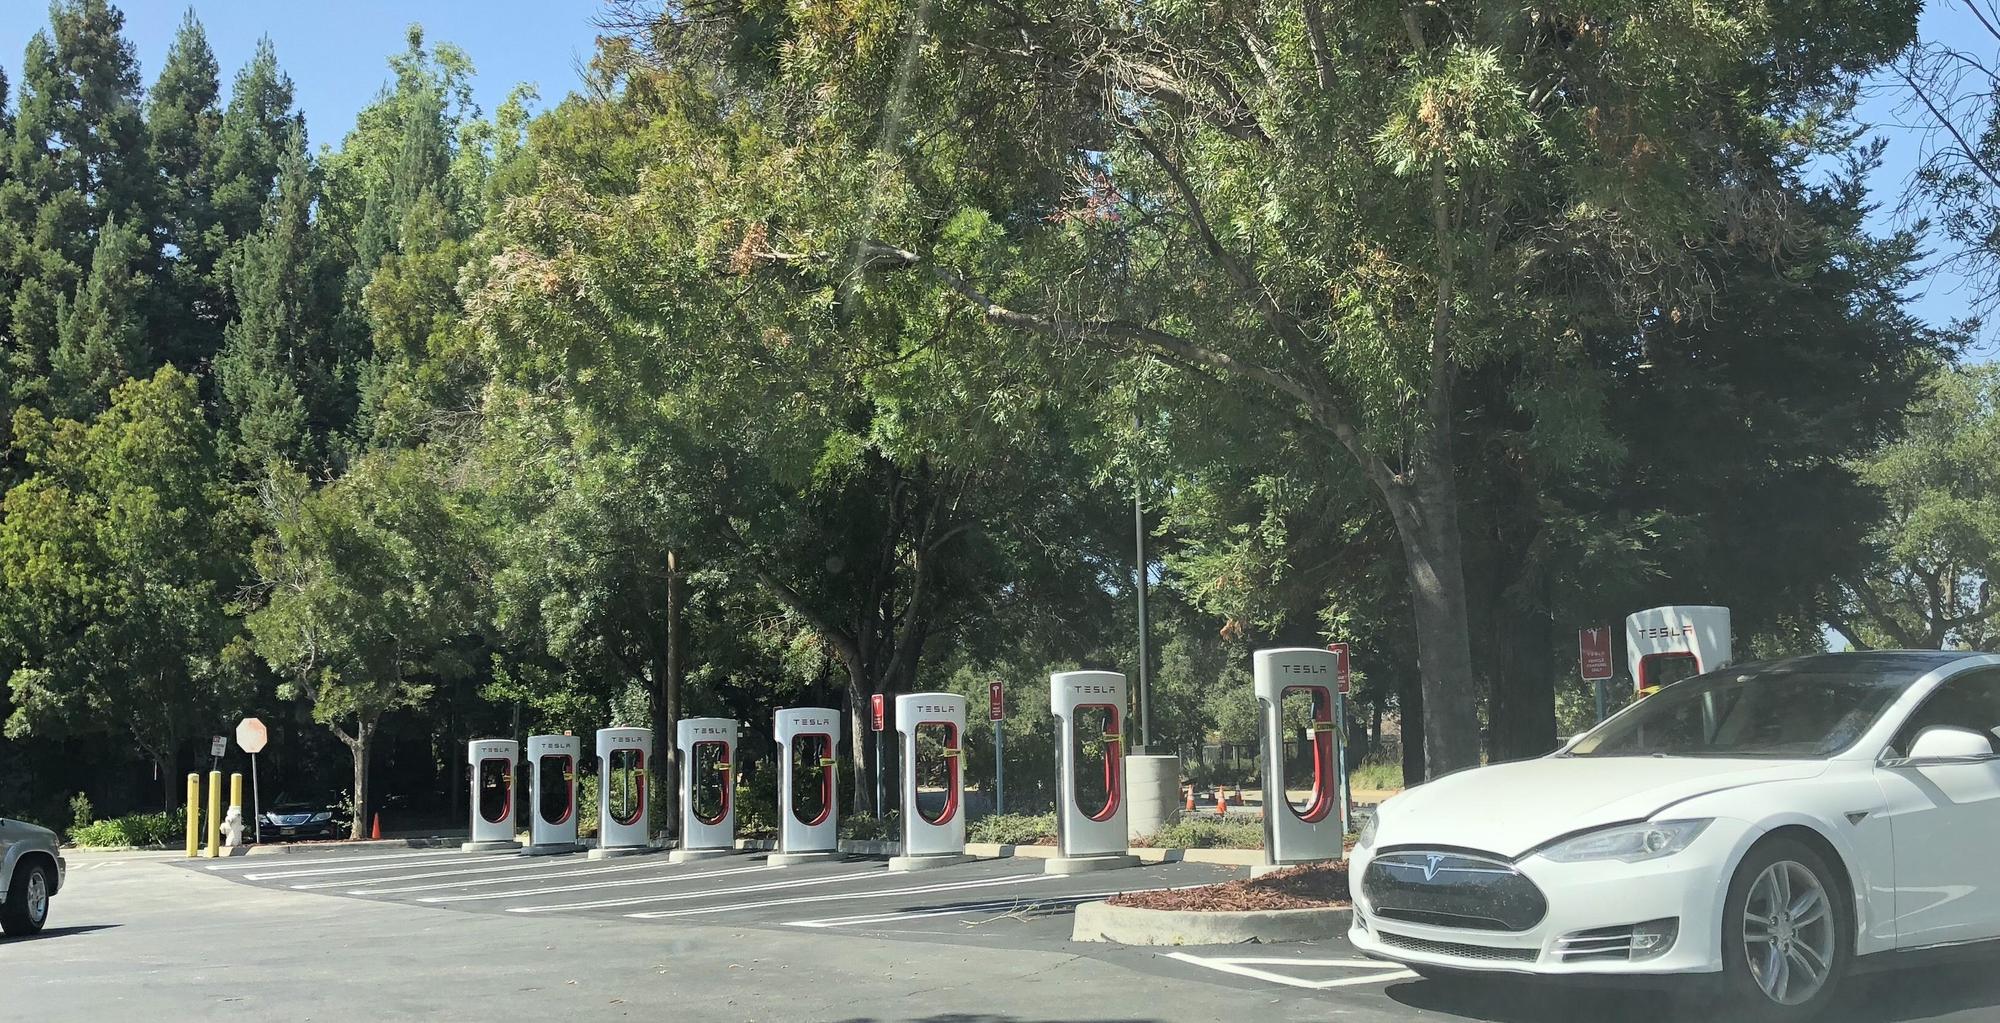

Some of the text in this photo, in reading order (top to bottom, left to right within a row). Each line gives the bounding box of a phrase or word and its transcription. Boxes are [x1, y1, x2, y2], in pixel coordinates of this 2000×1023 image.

[1639, 625, 1692, 639] TESLA
[1283, 664, 1327, 674] TESLA
[1074, 685, 1116, 694] TESLA
[916, 705, 955, 713] TESLA
[793, 718, 830, 726] TESLA
